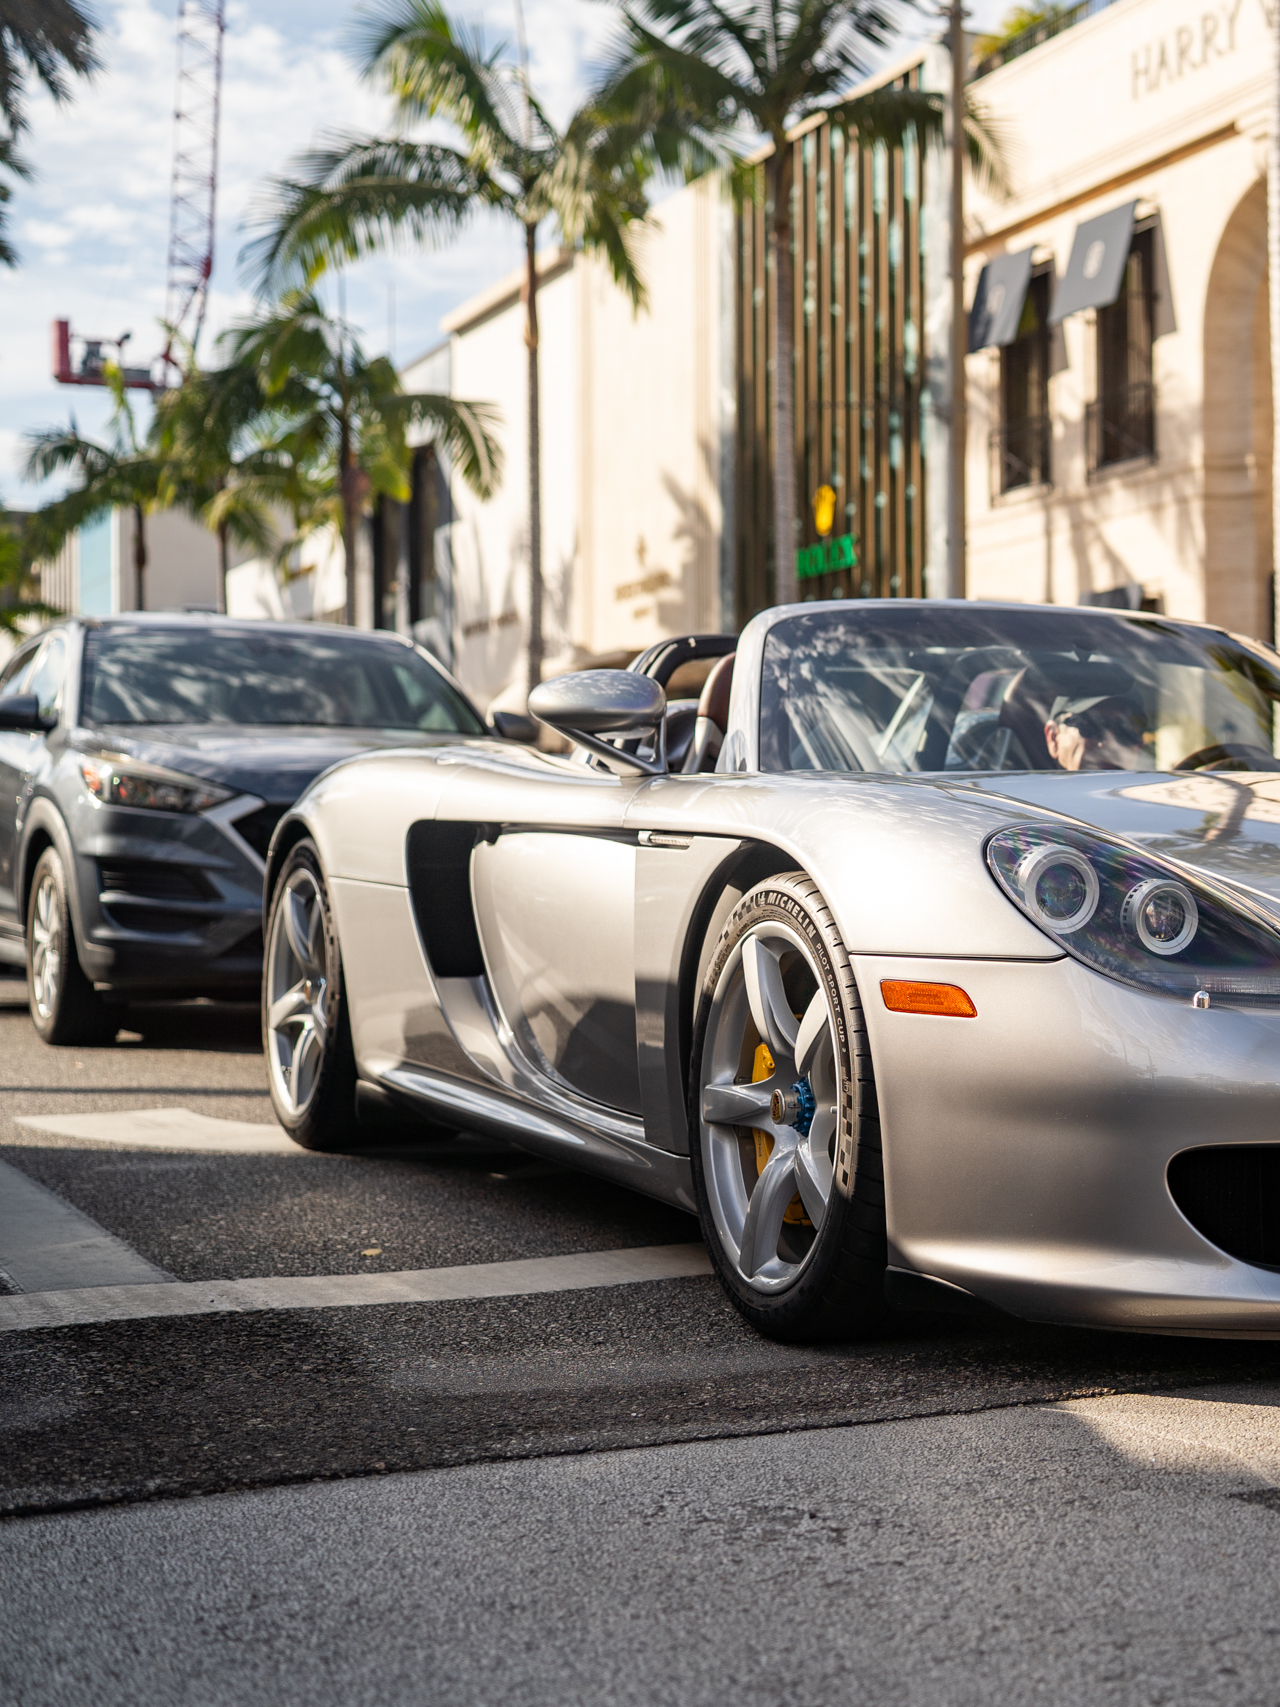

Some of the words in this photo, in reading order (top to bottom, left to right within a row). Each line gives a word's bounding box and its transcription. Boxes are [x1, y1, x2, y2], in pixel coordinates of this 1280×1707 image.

[1131, 0, 1243, 99] HARRY
[767, 892, 817, 938] MICHELIN
[816, 942, 830, 971] PILOT
[827, 974, 841, 1013] SPORT
[837, 1017, 846, 1043] CUP
